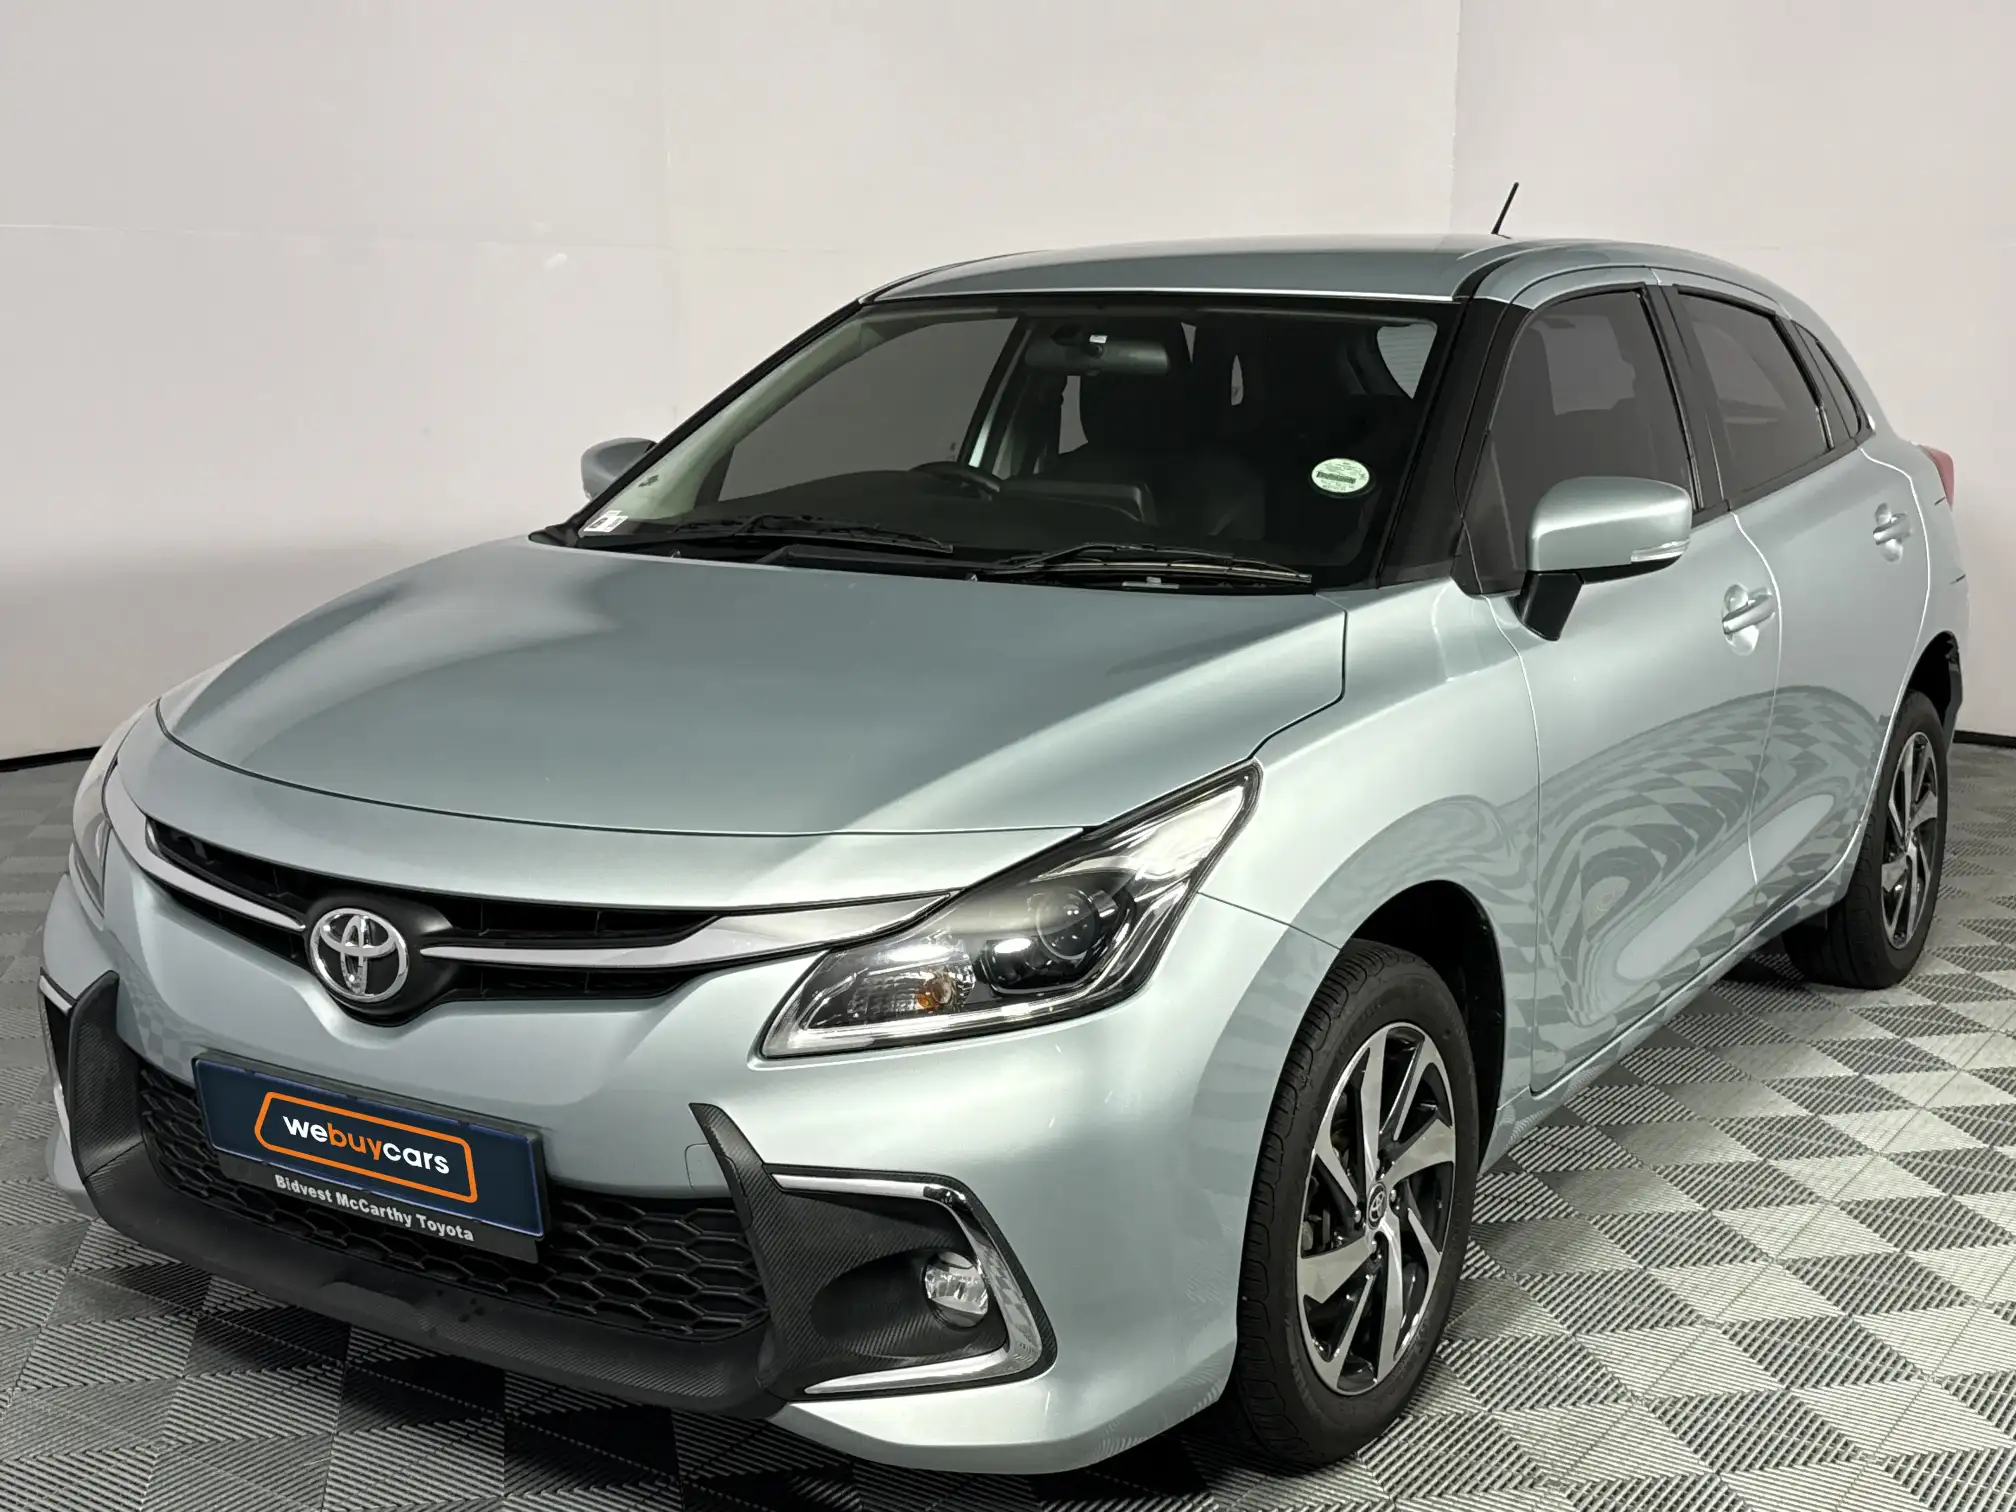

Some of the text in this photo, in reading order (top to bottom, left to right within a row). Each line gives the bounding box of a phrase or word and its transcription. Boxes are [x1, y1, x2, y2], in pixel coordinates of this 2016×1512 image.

[284, 1116, 450, 1174] webuycars
[275, 1174, 474, 1242] Bidvest McCarthy Toyota
